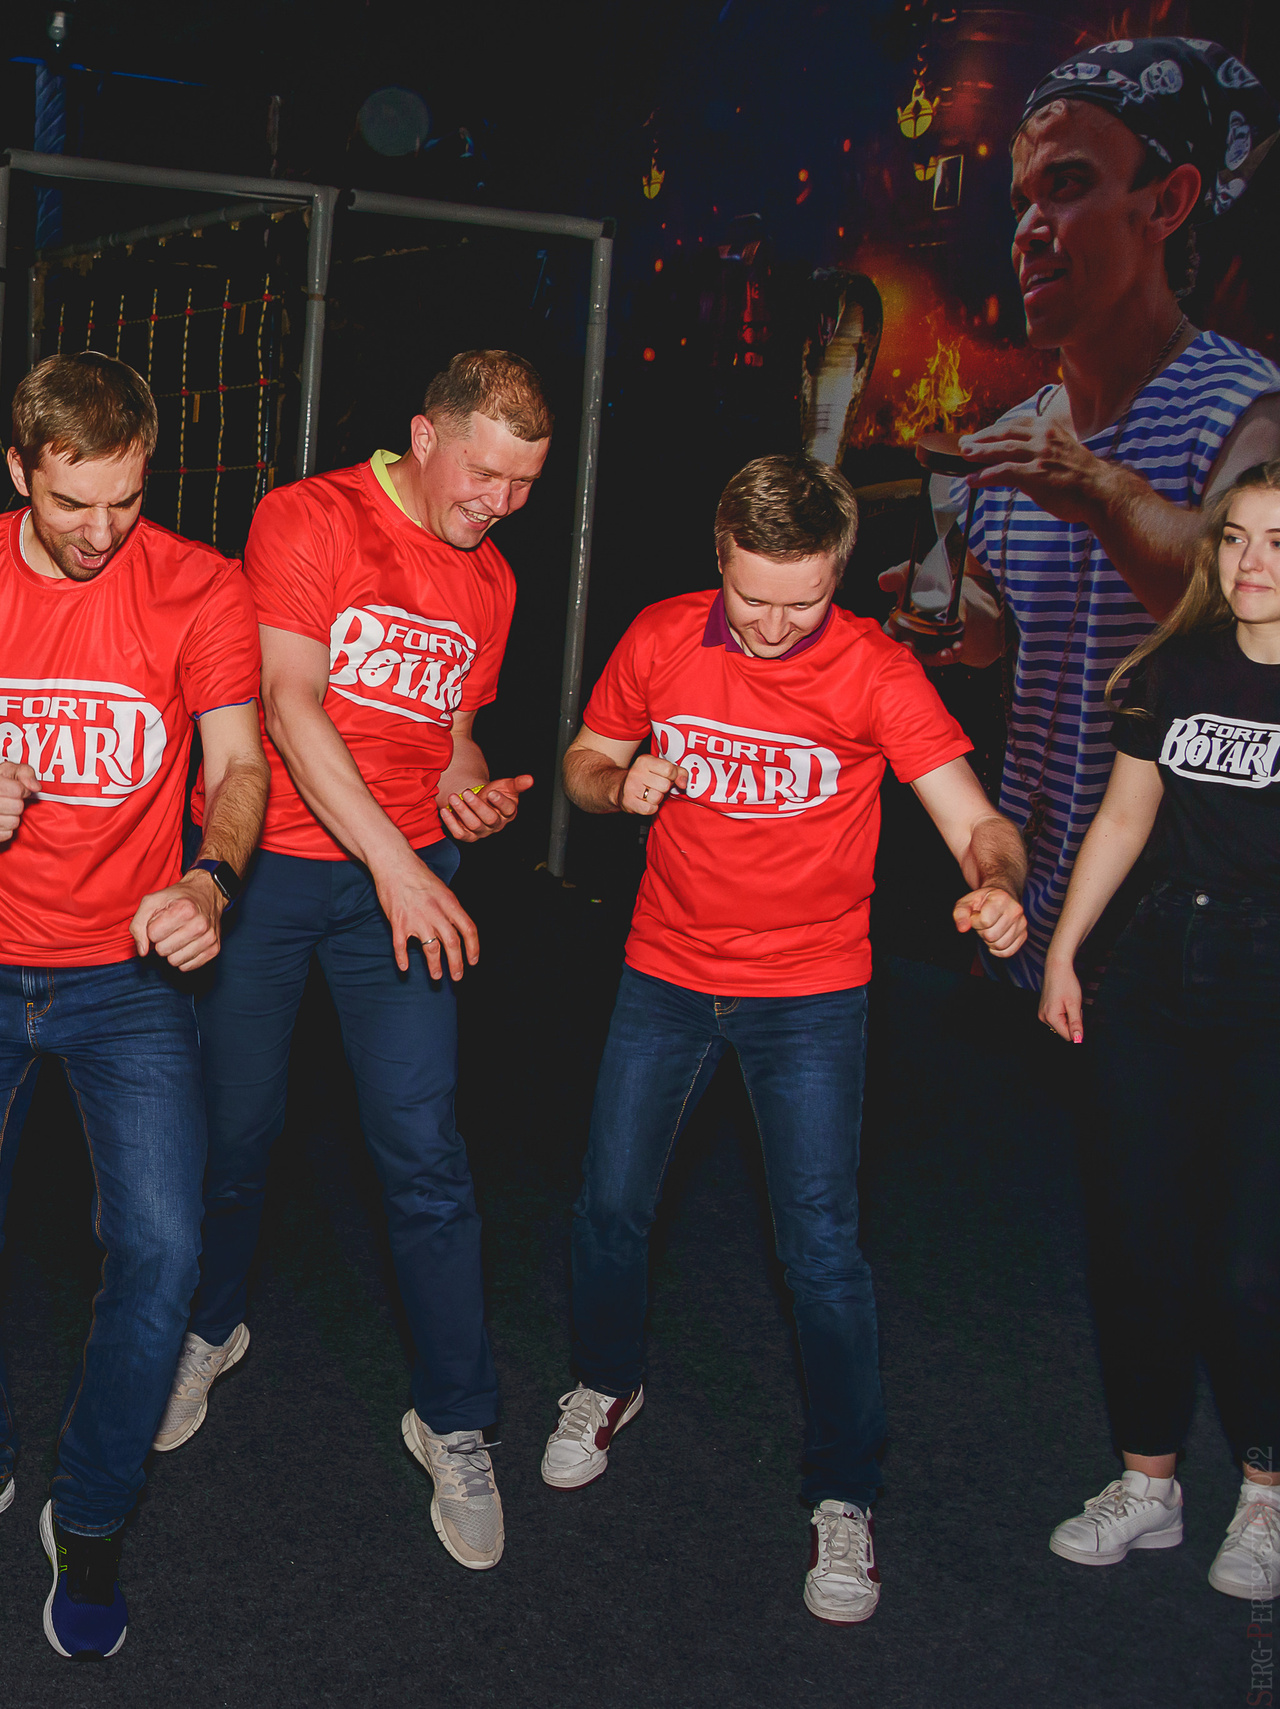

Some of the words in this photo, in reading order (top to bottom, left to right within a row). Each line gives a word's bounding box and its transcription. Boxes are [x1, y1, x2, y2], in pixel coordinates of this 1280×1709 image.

[385, 623, 462, 659] FORT
[686, 730, 783, 763] FORT
[1200, 721, 1268, 742] FORT
